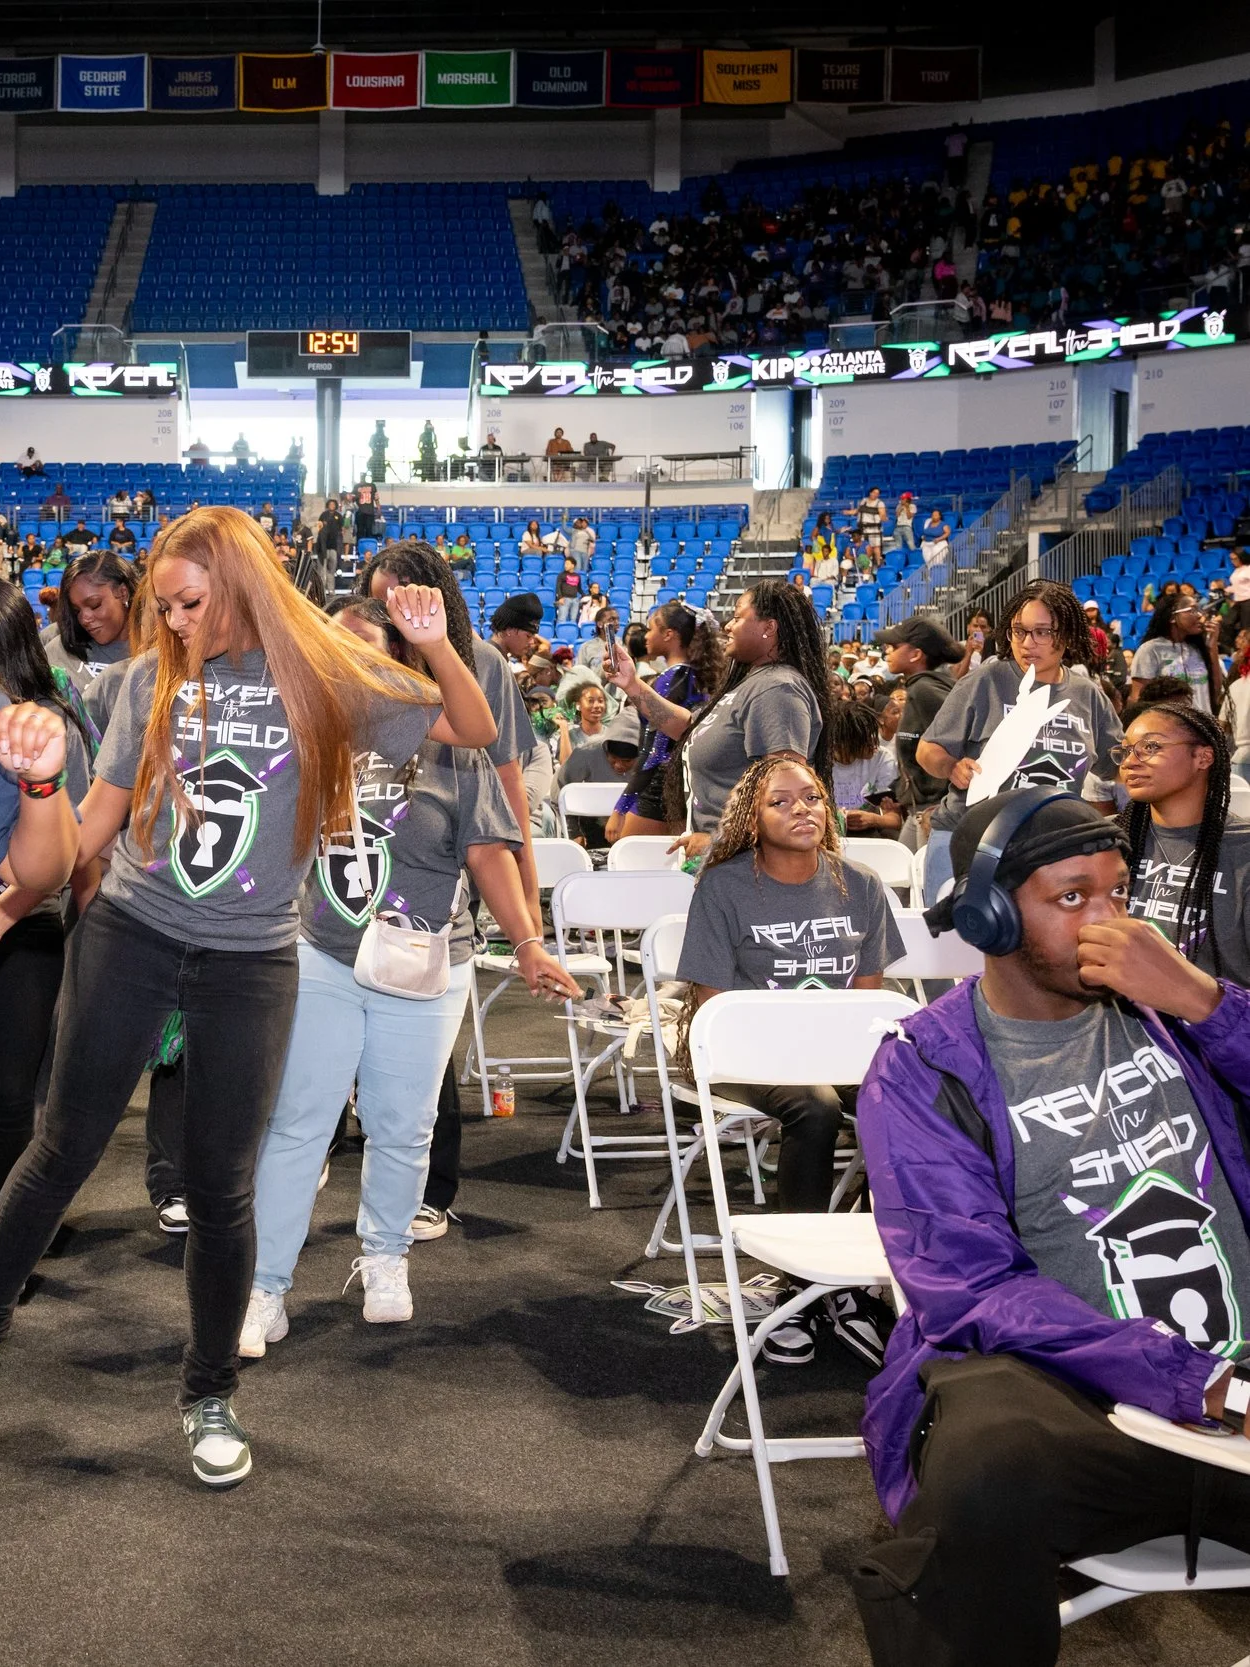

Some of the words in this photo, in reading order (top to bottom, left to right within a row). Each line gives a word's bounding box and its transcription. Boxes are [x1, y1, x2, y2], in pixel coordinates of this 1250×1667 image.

[716, 63, 778, 76] SOUTHERN
[822, 63, 861, 76] TEXAS
[78, 70, 127, 83] GEORGIA
[174, 71, 212, 83] JAMES
[345, 75, 405, 88] LOUISIANA
[437, 72, 498, 85] MARSHALL
[920, 71, 951, 83] TROY
[272, 77, 297, 90] ULM
[532, 80, 588, 93] DOMINION
[733, 79, 761, 92] MISS
[821, 78, 860, 91] STATE
[83, 85, 121, 97] STATE
[168, 86, 219, 98] MADISON
[309, 332, 357, 354] 12:54
[948, 330, 1063, 368] REVEAL
[1059, 328, 1090, 356] the
[1087, 320, 1181, 350] SHIELD
[822, 350, 883, 367] ATLANTA
[307, 362, 333, 371] PERIOD
[822, 362, 886, 377] COLLEGIATE
[69, 366, 174, 391] REVEAL
[485, 365, 591, 391] REVEAL
[588, 365, 615, 390] the
[613, 366, 693, 387] SHIELD
[1144, 369, 1163, 380] 210
[1049, 380, 1067, 391] 210
[730, 405, 745, 413] 209
[829, 399, 845, 408] 209
[1049, 399, 1065, 410] 107
[157, 410, 172, 418] 208
[729, 423, 744, 431] 106
[828, 417, 844, 426] 107
[157, 426, 172, 434] 105
[216, 699, 251, 720] the
[176, 716, 289, 750] SHIELD
[1031, 736, 1086, 756] HIELD
[1145, 874, 1176, 899] the
[750, 915, 860, 949] REVEAL
[798, 934, 827, 959] the
[773, 954, 856, 977] SHIELD
[1008, 1045, 1186, 1143] REVEAL
[1102, 1097, 1147, 1142] the
[1070, 1113, 1197, 1188] SHIELD
